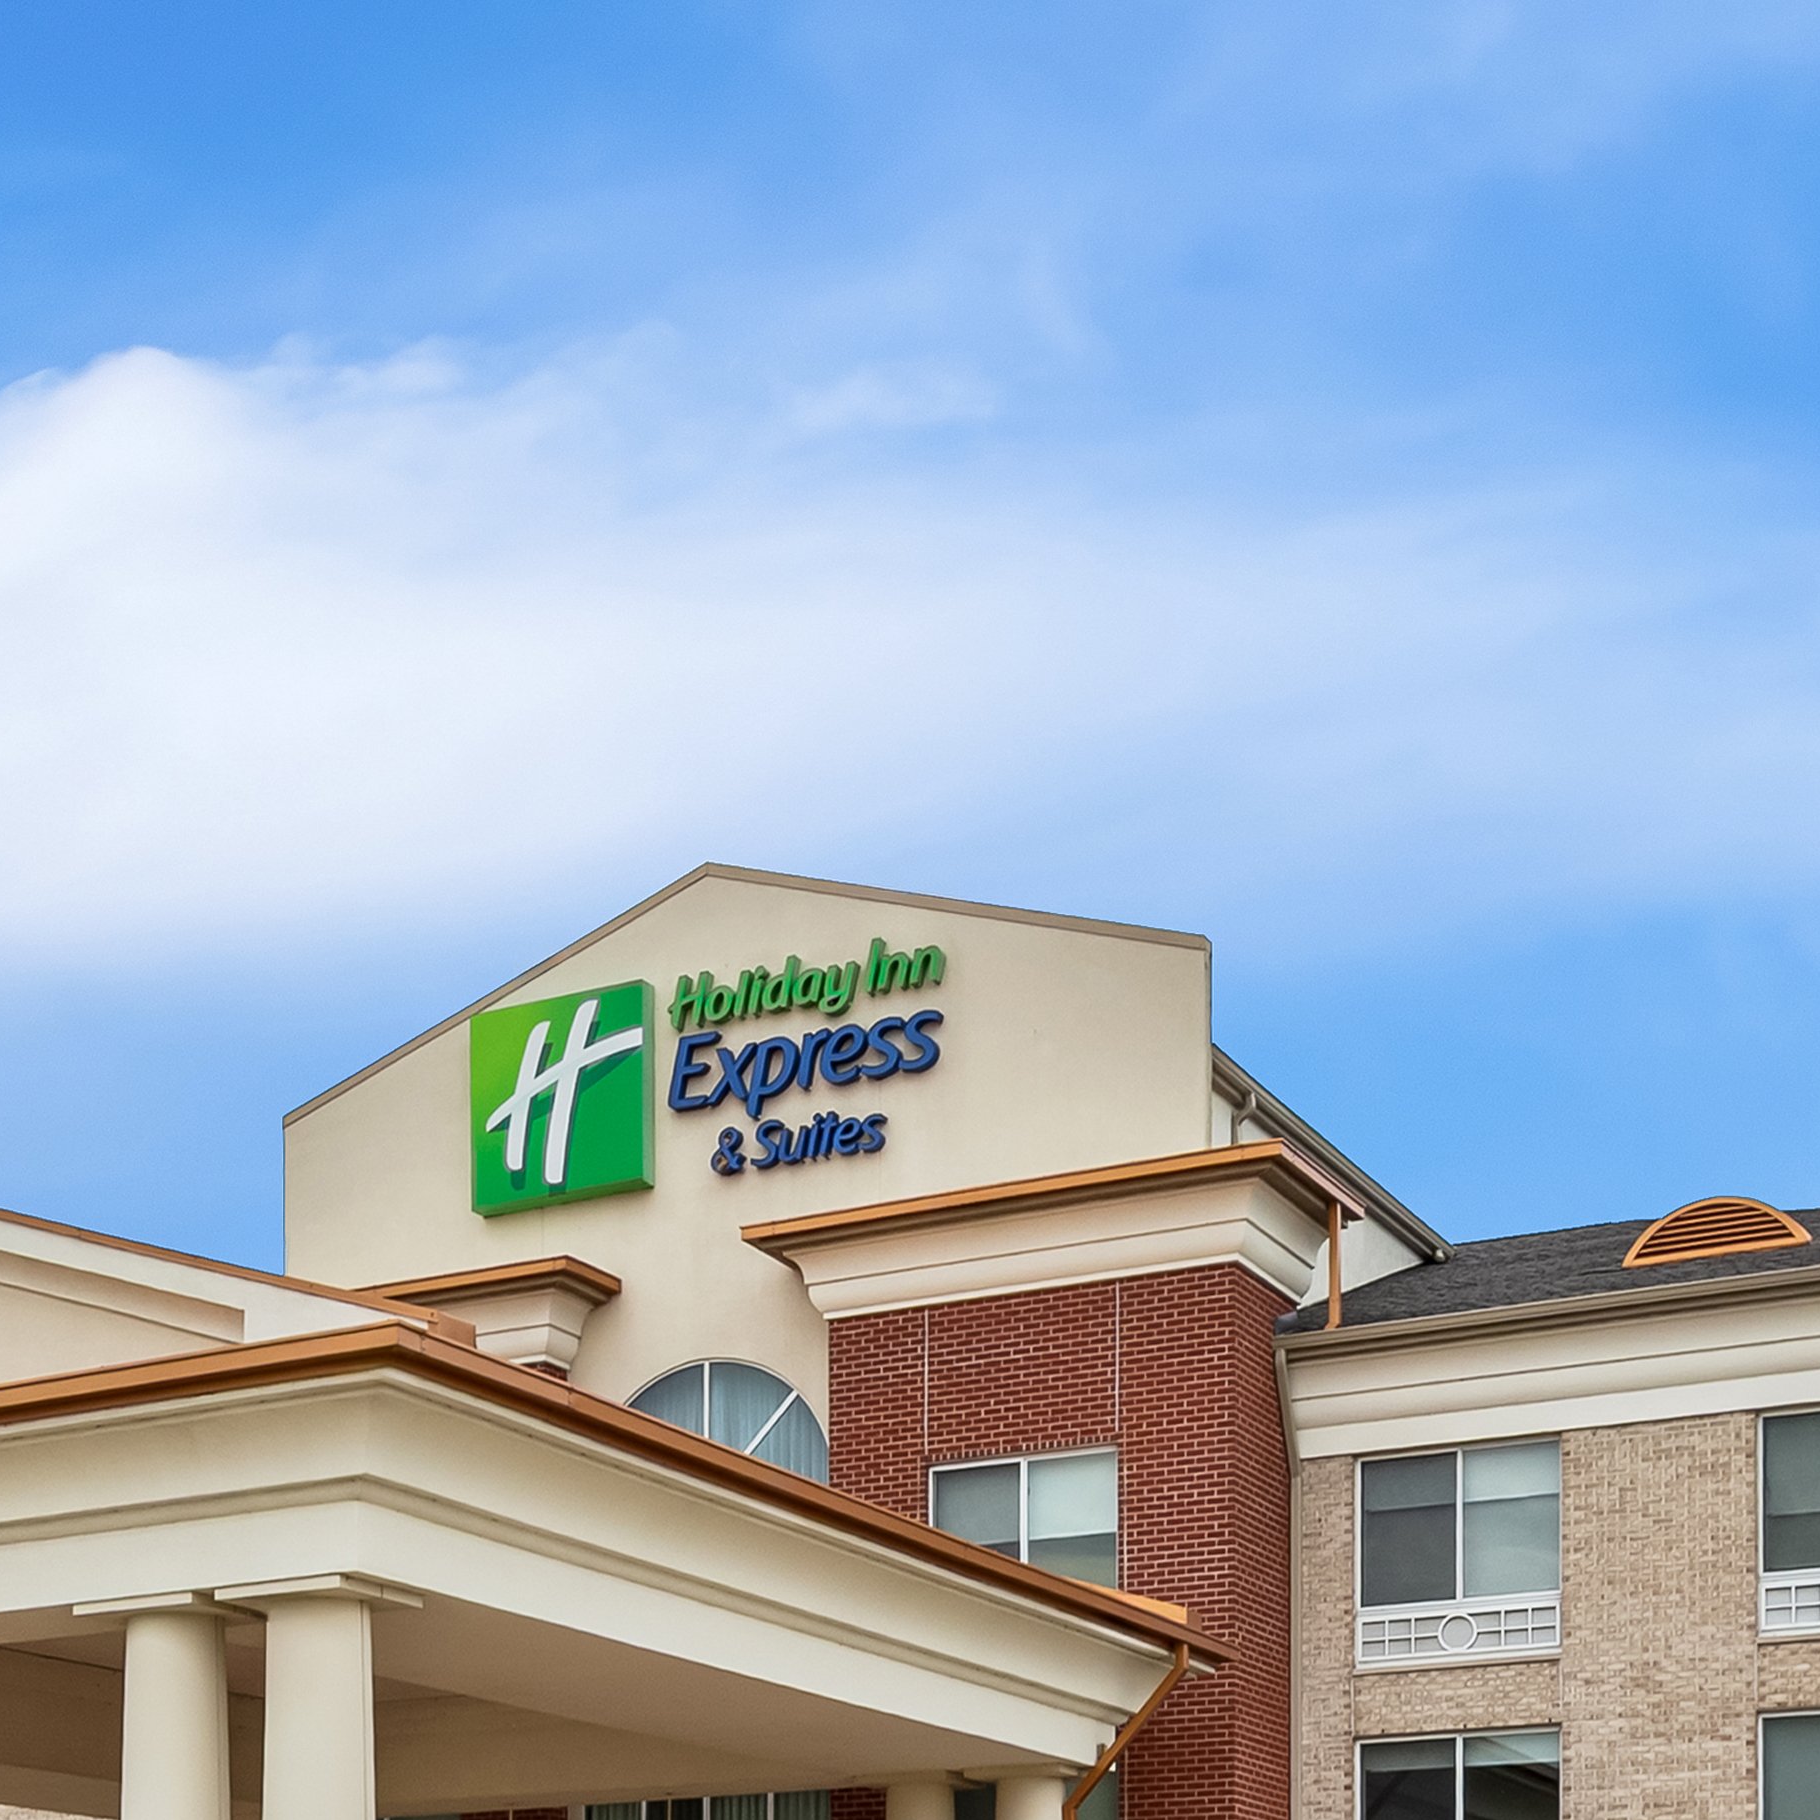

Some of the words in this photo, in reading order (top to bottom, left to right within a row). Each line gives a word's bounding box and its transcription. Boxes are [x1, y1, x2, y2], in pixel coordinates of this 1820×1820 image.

[667, 954, 861, 1032] Holiday
[866, 937, 947, 996] Inn
[667, 1009, 945, 1120] Express
[710, 1126, 747, 1176] &
[750, 1111, 888, 1169] Suites
